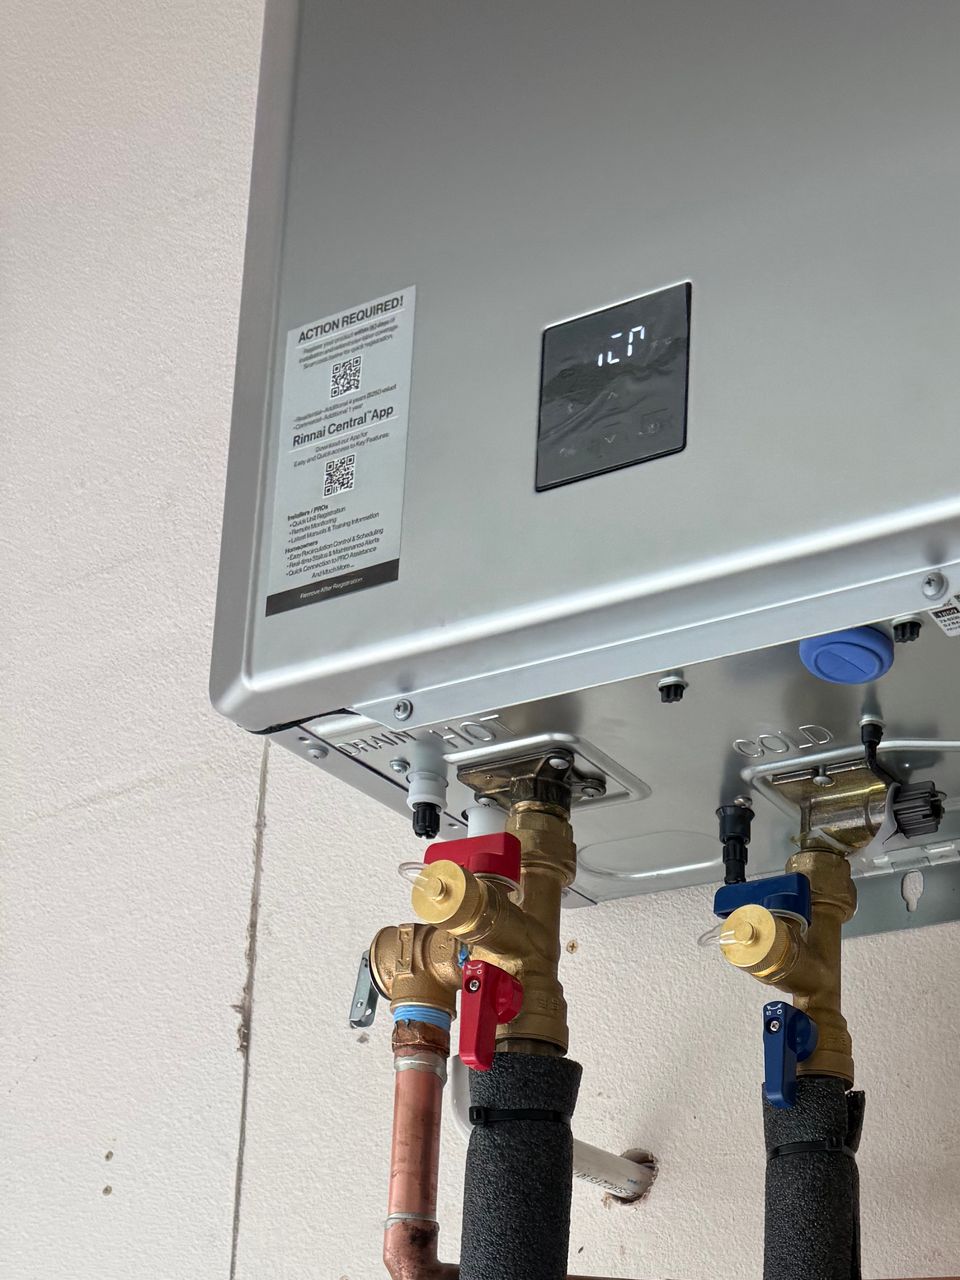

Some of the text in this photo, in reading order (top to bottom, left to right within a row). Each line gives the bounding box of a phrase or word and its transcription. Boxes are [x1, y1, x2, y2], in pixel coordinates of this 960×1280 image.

[298, 295, 403, 343] ACTION REQUIRED!
[292, 425, 325, 447] Rinnai
[371, 402, 394, 422] App
[334, 714, 519, 757] DRAIN HOT
[733, 725, 834, 758] COLD
